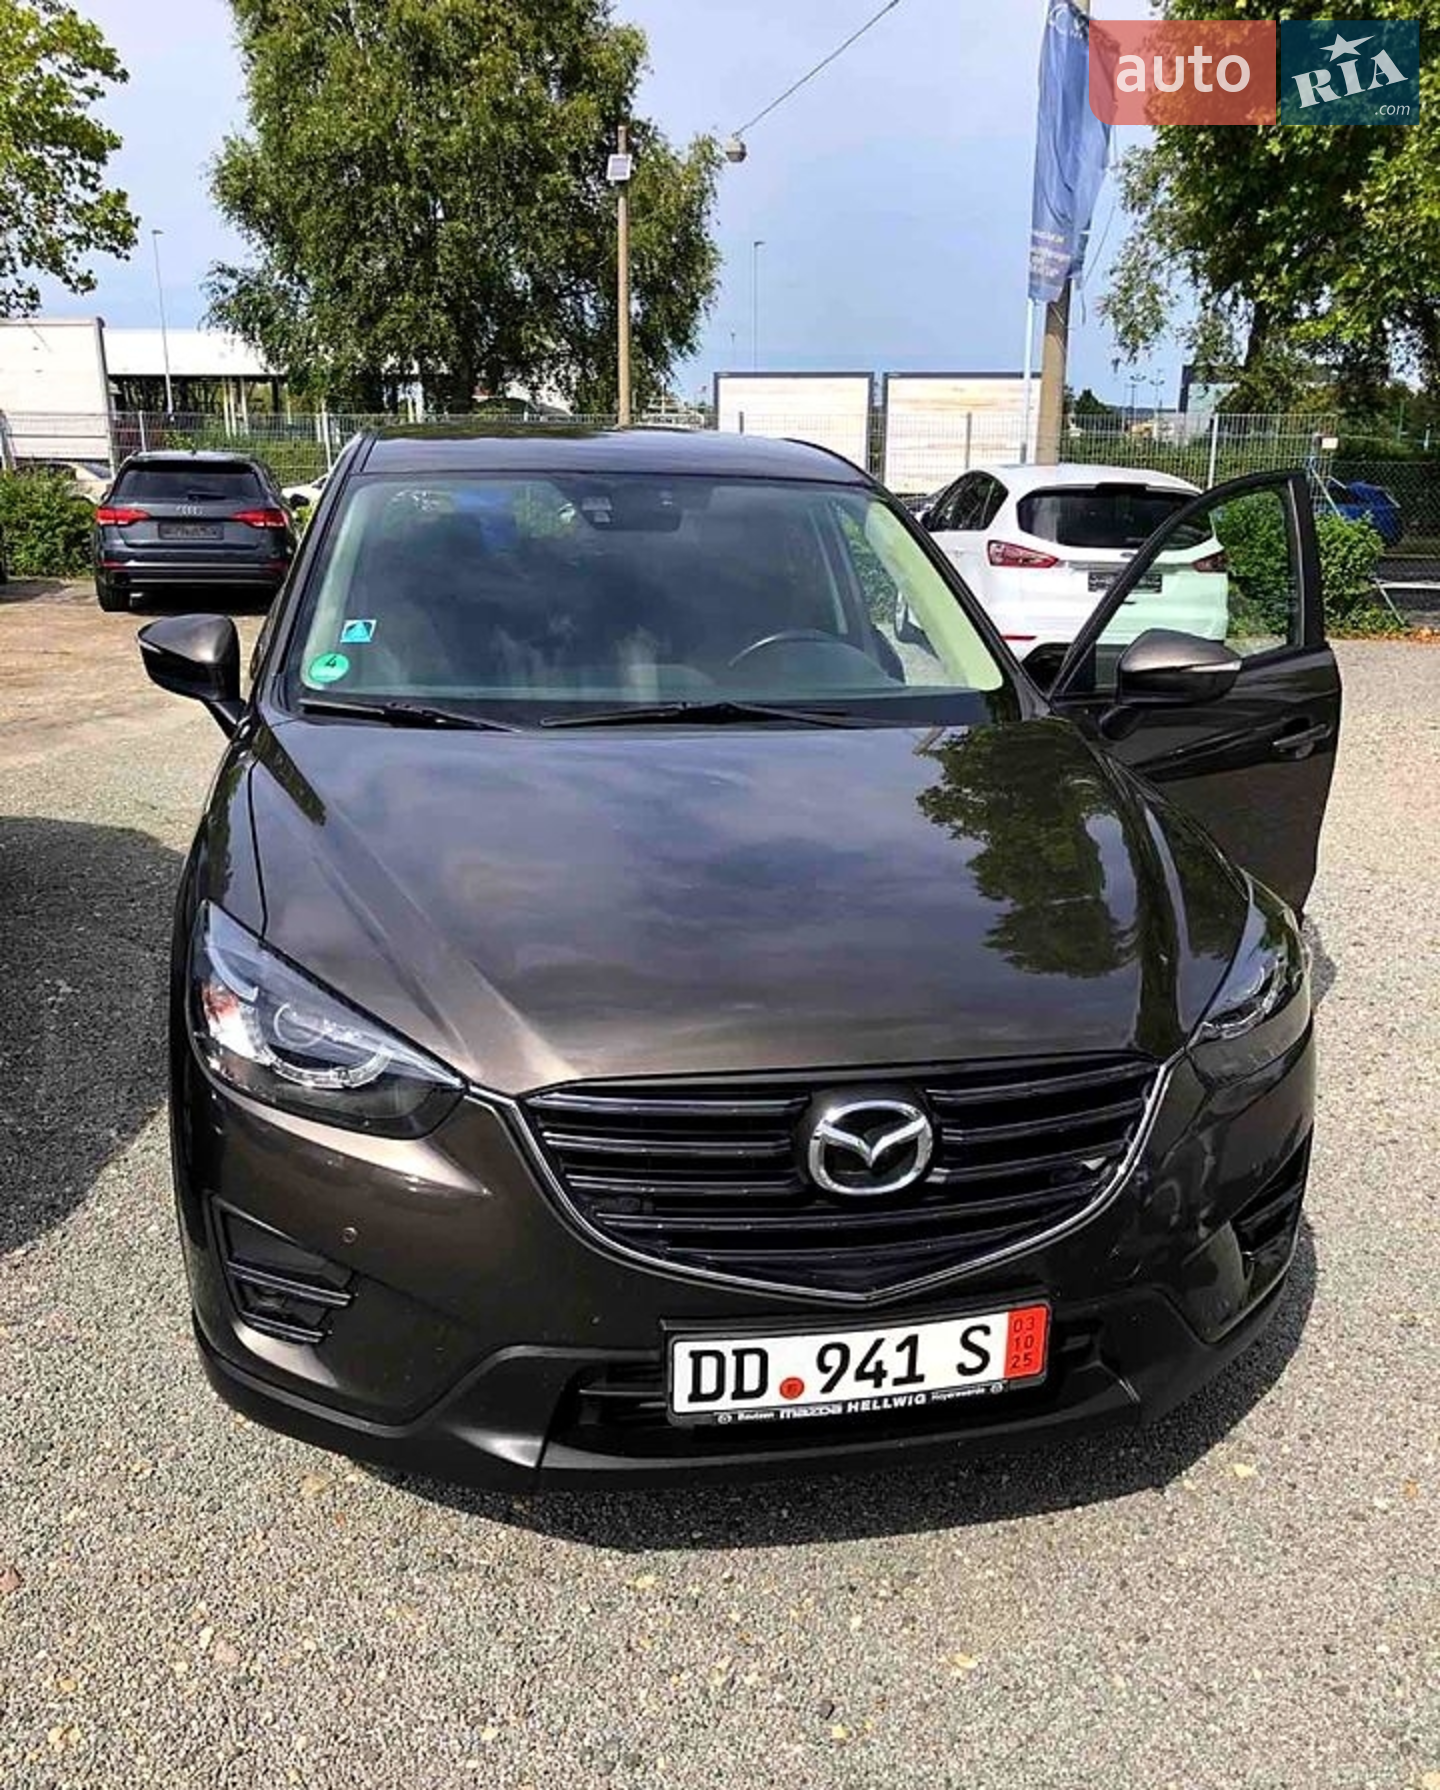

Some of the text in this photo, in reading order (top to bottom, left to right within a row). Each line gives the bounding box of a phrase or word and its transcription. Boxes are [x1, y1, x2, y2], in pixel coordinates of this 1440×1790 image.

[325, 655, 337, 668] 4
[1013, 1316, 1035, 1333] 03
[1014, 1334, 1035, 1352] 10
[688, 1324, 992, 1403] DD 941 S
[1011, 1352, 1033, 1369] 25
[846, 1392, 927, 1414] HELLWIG
